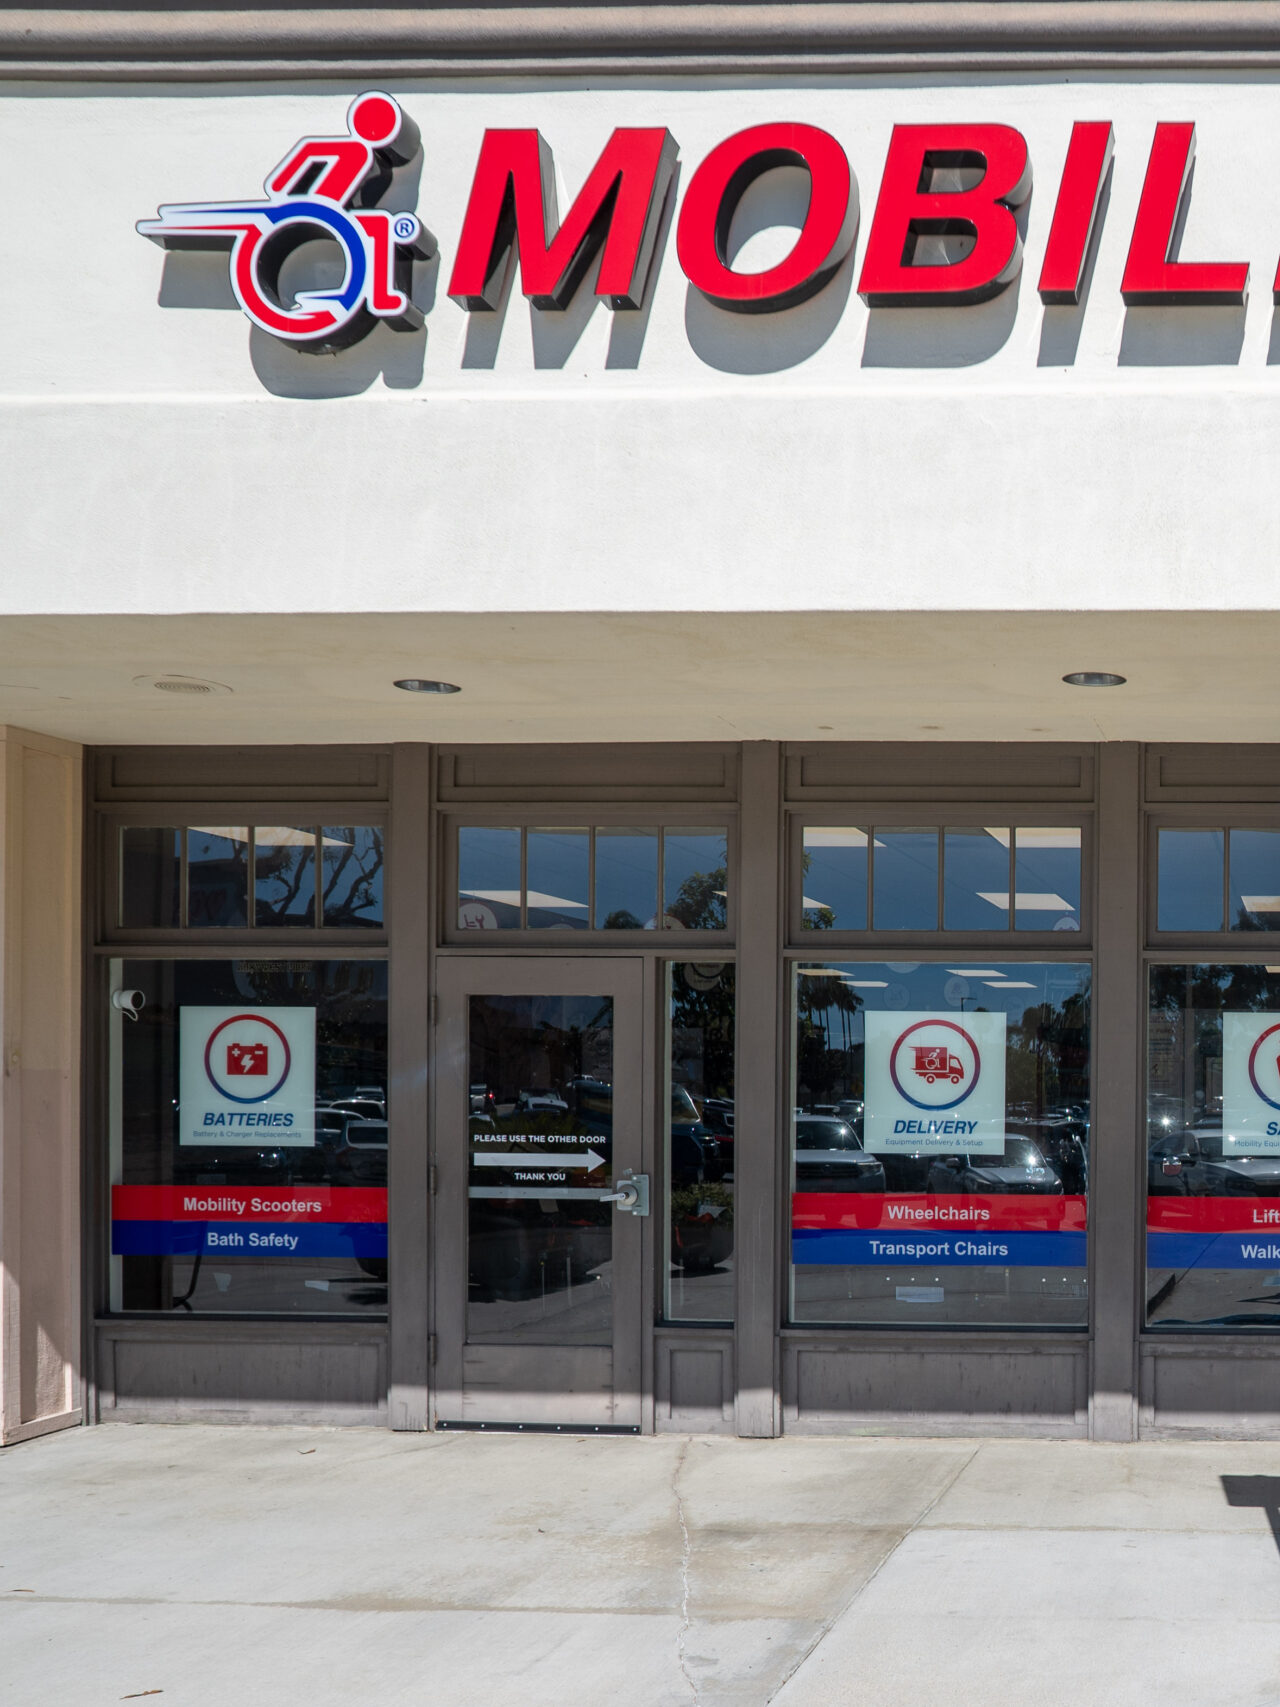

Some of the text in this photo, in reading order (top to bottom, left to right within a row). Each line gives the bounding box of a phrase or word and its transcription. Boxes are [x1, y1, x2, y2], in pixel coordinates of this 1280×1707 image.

[203, 1112, 294, 1127] BATTERIES
[893, 1119, 978, 1134] DELIVERY
[193, 1130, 217, 1139] Battery
[226, 1131, 252, 1139] Charger
[254, 1131, 302, 1139] Replacements
[473, 1134, 606, 1144] PLEASE USE THE OTHER DOOR
[885, 1138, 923, 1147] Equipment
[925, 1138, 953, 1147] Delivery
[962, 1139, 983, 1147] Setup
[1234, 1140, 1262, 1149] Mobility
[513, 1172, 566, 1181] THANK YOU
[183, 1197, 323, 1215] Mobility Scooters
[887, 1205, 990, 1221] Wheelchairs
[1253, 1209, 1280, 1224] Lift
[207, 1232, 299, 1250] Bath Safety
[869, 1241, 1009, 1259] Transport Chairs
